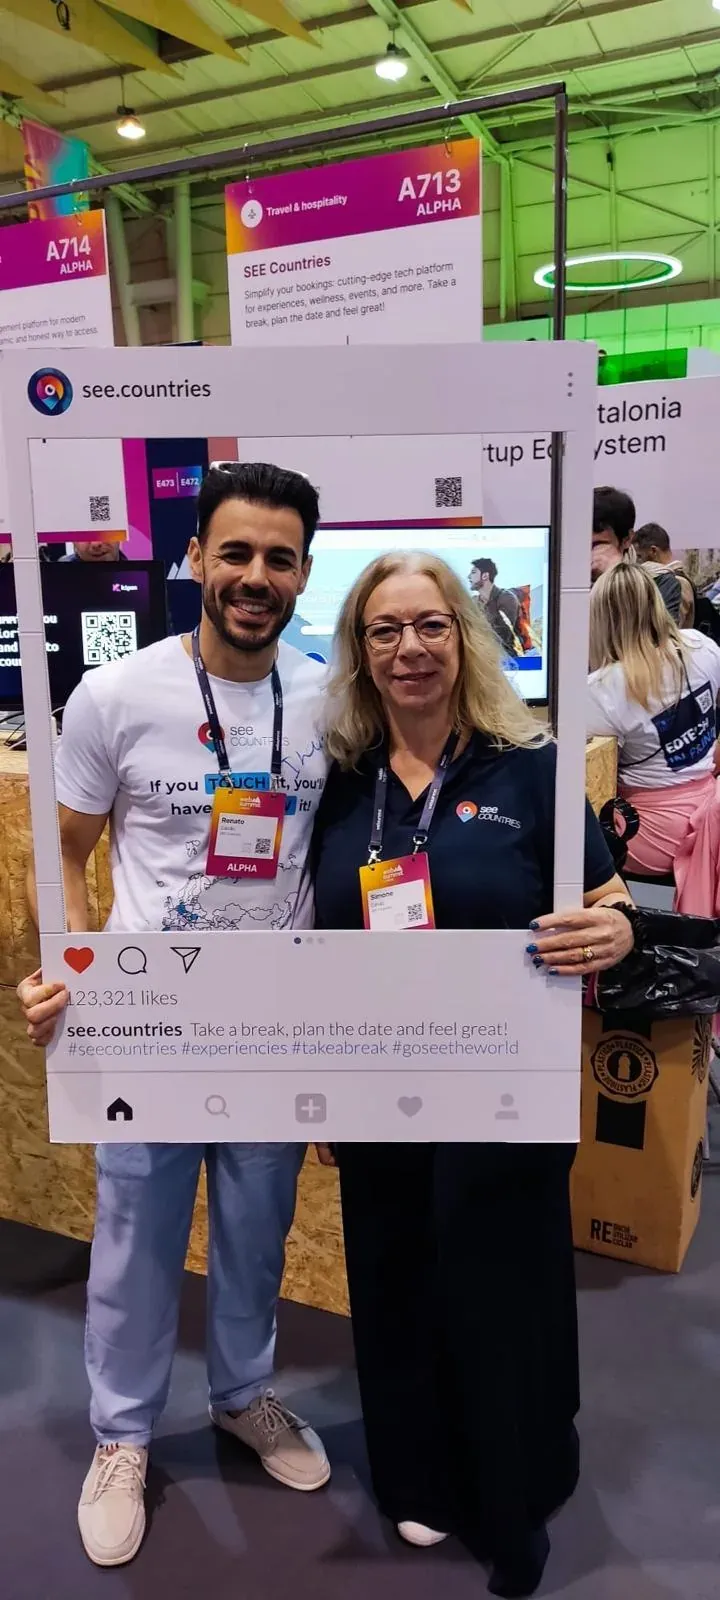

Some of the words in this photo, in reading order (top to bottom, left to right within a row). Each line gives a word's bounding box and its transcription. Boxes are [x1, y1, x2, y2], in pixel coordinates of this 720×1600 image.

[398, 168, 461, 202] A713
[266, 203, 293, 217] Travel
[294, 202, 301, 213] &
[301, 195, 348, 211] hospitality
[416, 197, 462, 217] ALPHA
[46, 235, 92, 262] A714
[60, 260, 94, 275] ALPHA
[244, 263, 267, 279] SEE
[269, 255, 332, 275] Countries
[245, 287, 275, 300] Simplify
[276, 286, 294, 298] your
[296, 280, 335, 294] bookings:
[337, 270, 392, 286] cutting-edge
[394, 267, 414, 279] tech
[416, 262, 454, 276] platform
[245, 304, 255, 314] for
[257, 299, 307, 313] experiences,
[309, 293, 345, 306] wellness,
[349, 287, 380, 300] events,
[381, 285, 398, 296] and
[427, 277, 448, 289] Take
[451, 279, 457, 287] a
[22, 319, 50, 331] platform
[60, 314, 86, 323] modern
[245, 317, 269, 330] break,
[271, 315, 289, 327] plan
[290, 312, 303, 323] the
[305, 309, 324, 321] date
[325, 307, 341, 318] and
[343, 305, 359, 316] feel
[360, 303, 385, 316] great!
[51, 330, 64, 340] way
[66, 329, 73, 337] to
[82, 379, 211, 398] see.countries
[597, 396, 682, 424] talonia
[483, 443, 524, 467] tup
[156, 479, 175, 488] E473
[180, 477, 199, 487] E472
[45, 642, 60, 652] to
[230, 725, 254, 736] see
[150, 780, 161, 793] If
[165, 780, 199, 795] you
[208, 776, 266, 790] TOUCH
[276, 776, 290, 791] it,
[171, 803, 212, 816] have
[299, 800, 312, 812] it!
[480, 806, 499, 814] see
[221, 817, 245, 825] Renato
[478, 813, 521, 829] COUNTRIES
[227, 863, 257, 873] ALPHA
[370, 891, 394, 901] Simone
[67, 990, 137, 1007] 123,321
[141, 990, 178, 1006] likes
[67, 1022, 183, 1037] see.countries
[190, 1022, 225, 1037] Take
[229, 1026, 237, 1037] a
[241, 1022, 289, 1039] break,
[292, 1022, 325, 1039] plan
[329, 1022, 354, 1037] the
[358, 1022, 393, 1037] date
[396, 1022, 425, 1037] and
[429, 1022, 457, 1037] feel
[461, 1022, 508, 1039] great!
[68, 1041, 177, 1056] #seecountries
[182, 1041, 288, 1058] #experiencies
[291, 1040, 388, 1056] #takeabreak
[392, 1040, 519, 1058] #goseetheworld
[591, 1218, 613, 1244] RE
